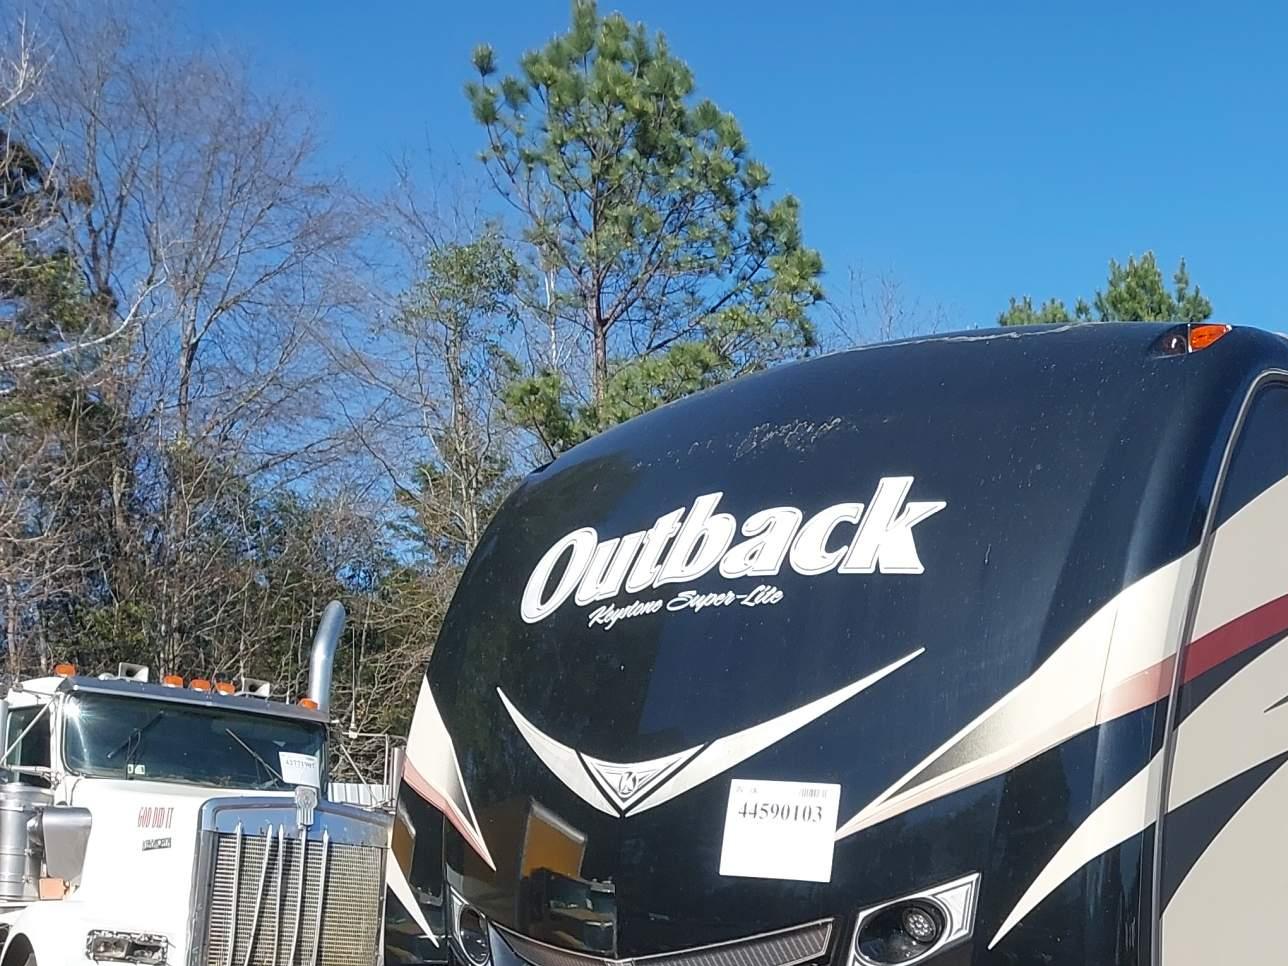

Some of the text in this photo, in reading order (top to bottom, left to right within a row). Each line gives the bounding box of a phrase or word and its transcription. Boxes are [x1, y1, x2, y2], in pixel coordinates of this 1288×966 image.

[520, 476, 947, 625] Outback
[588, 599, 663, 630] Keystone
[738, 802, 822, 822] 44590103
